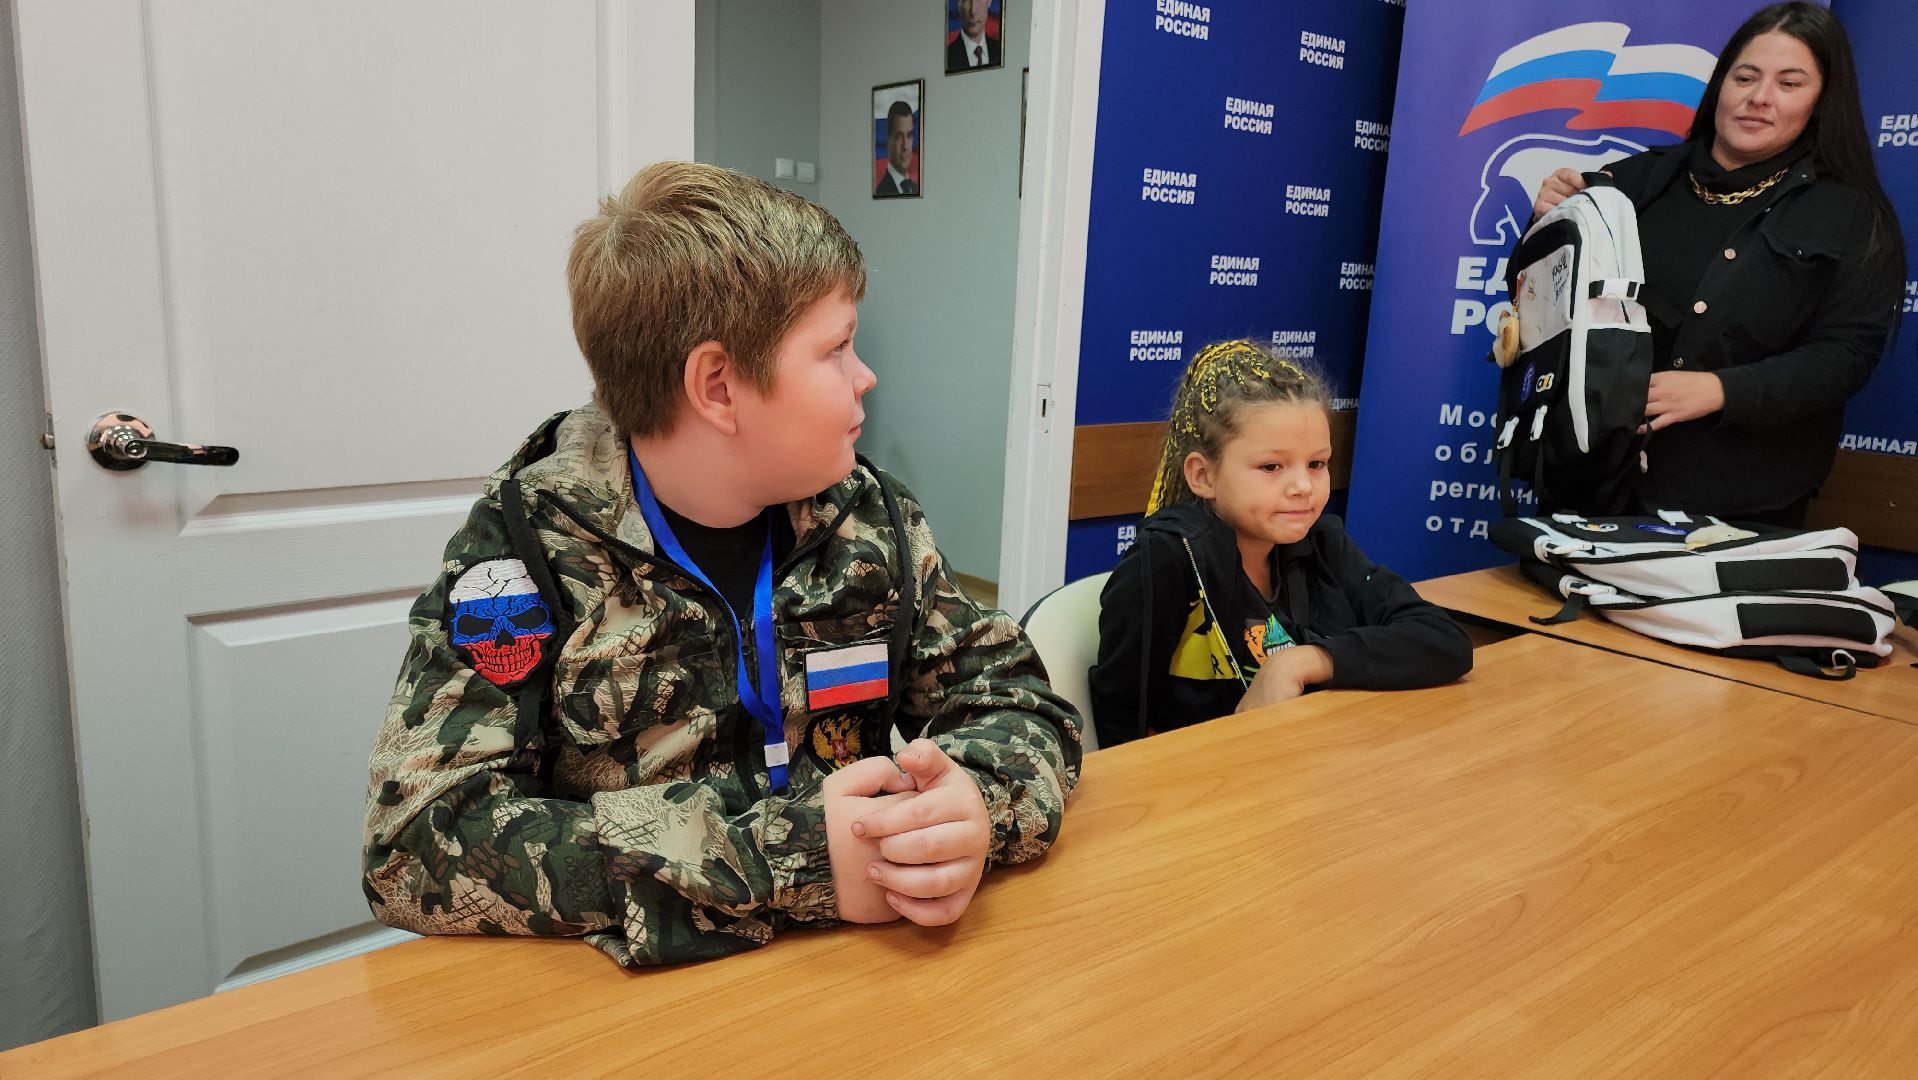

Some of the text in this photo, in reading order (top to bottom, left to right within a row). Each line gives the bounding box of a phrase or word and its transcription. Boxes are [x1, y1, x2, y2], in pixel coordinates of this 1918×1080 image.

[1156, 0, 1211, 23] ЕДИНАЯ
[1155, 14, 1209, 41] РОССИЯ
[1300, 30, 1346, 54] ЕДИНАЯ
[1299, 47, 1344, 70] РОССИЯ
[1225, 96, 1275, 118] ЕДИНАЯ
[1224, 114, 1273, 135] РОССИЯ
[1355, 119, 1390, 137] ЕДИНА
[1143, 167, 1198, 188] ЕДИНАЯ
[1141, 185, 1196, 205] РОССИЯ
[1285, 184, 1331, 202] ЕДИНАЯ
[1285, 200, 1329, 218] РОССИЯ
[1211, 254, 1260, 271] ЕДИНАЯ
[1209, 271, 1258, 287] РОССИЯ
[1130, 330, 1183, 347] ЕДИНАЯ
[1272, 331, 1317, 346] ЕДИНАЯ
[1129, 346, 1182, 362] РОССИЯ
[1838, 433, 1918, 456] ДИНАЯ
